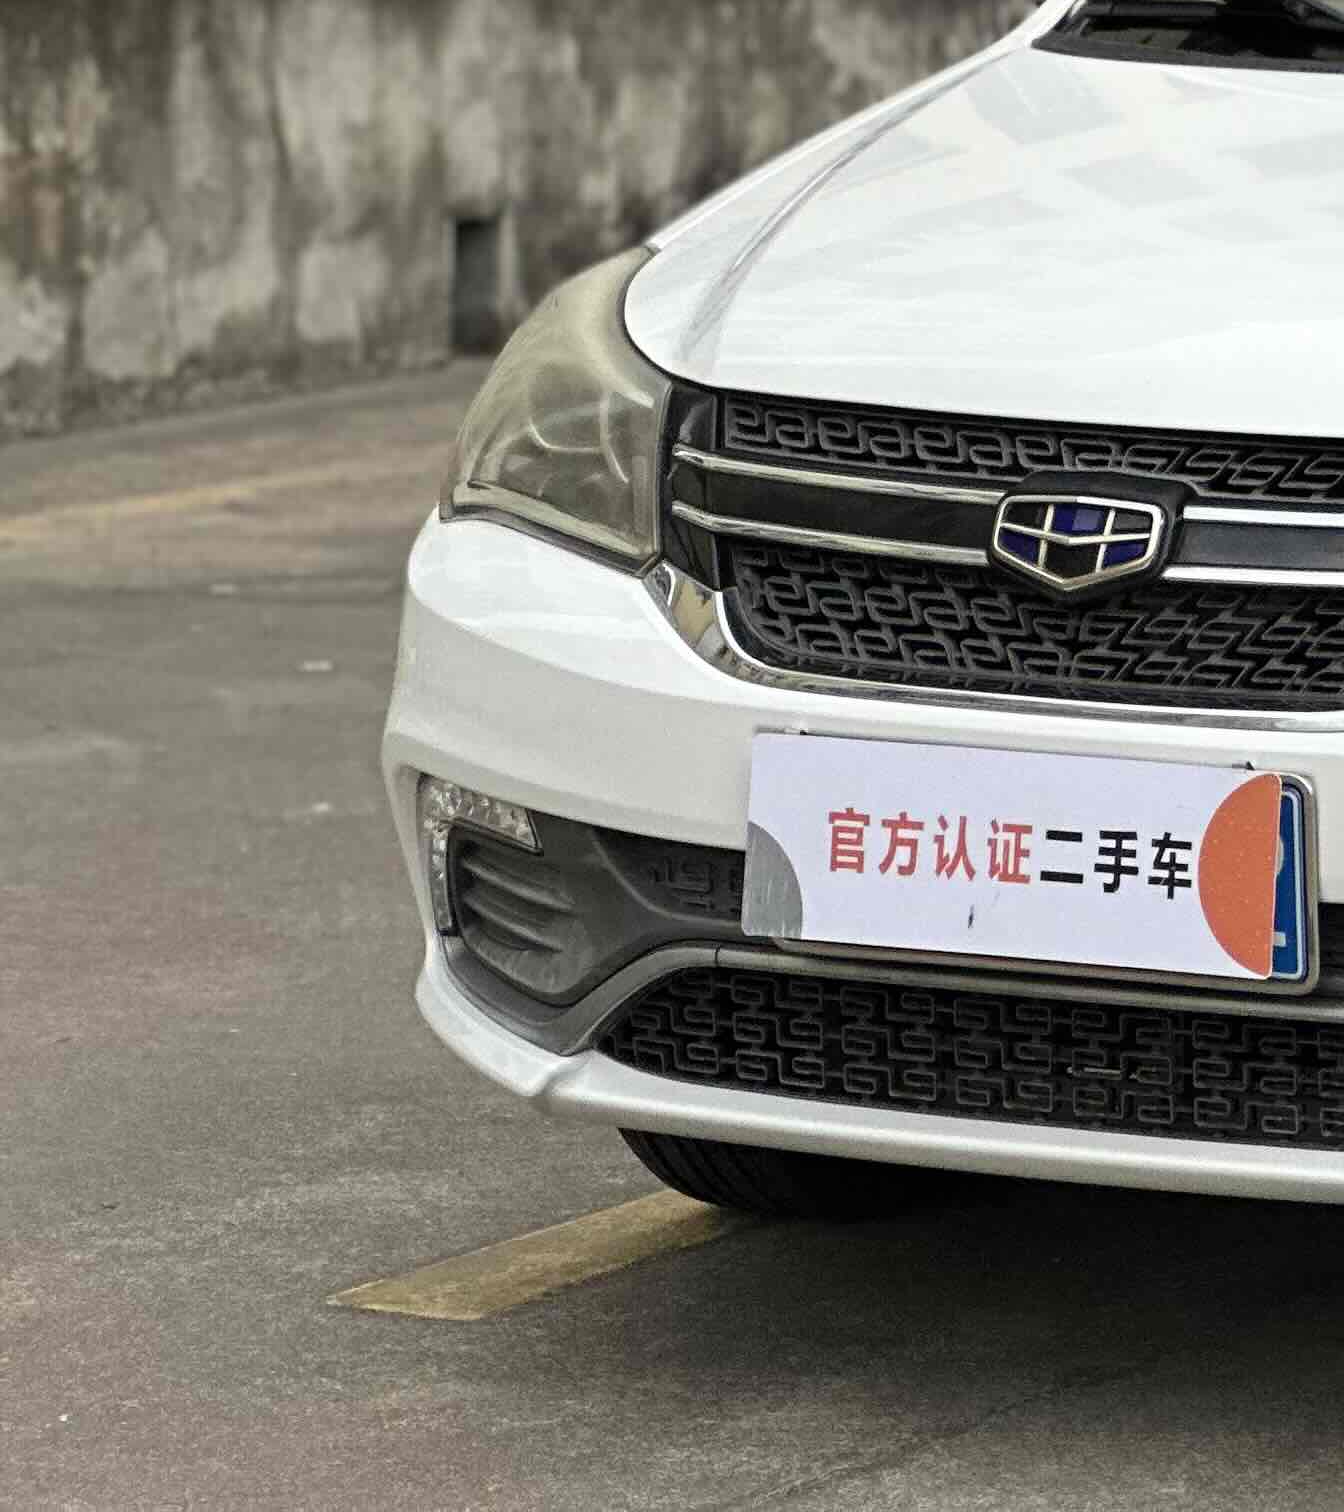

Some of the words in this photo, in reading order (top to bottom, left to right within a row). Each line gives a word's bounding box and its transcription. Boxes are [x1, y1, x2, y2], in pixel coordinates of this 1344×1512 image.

[828, 807, 1194, 899] 官方认证二手车
